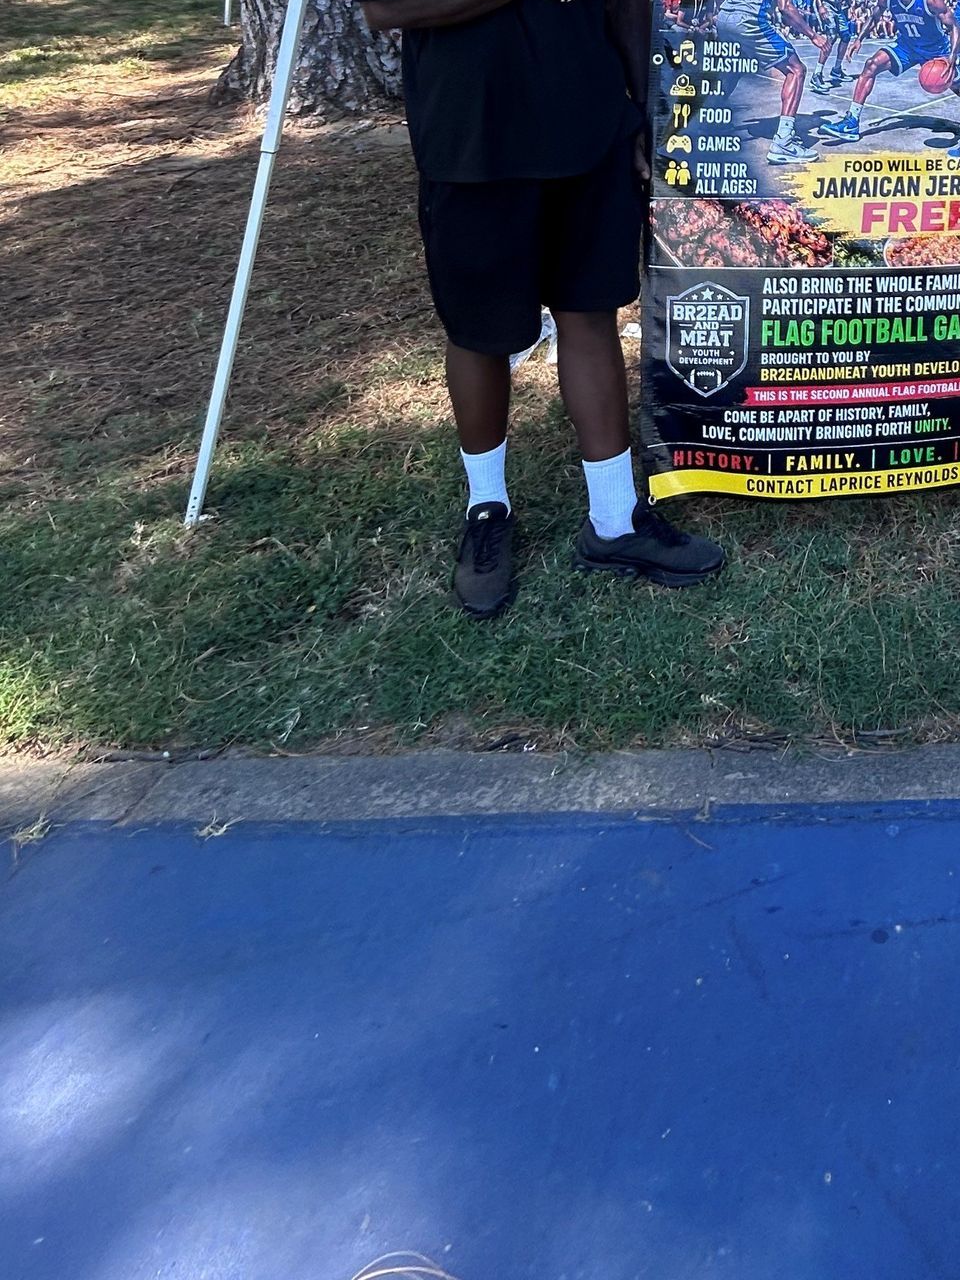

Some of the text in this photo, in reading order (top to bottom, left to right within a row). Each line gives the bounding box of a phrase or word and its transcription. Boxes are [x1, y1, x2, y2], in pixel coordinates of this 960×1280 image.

[904, 23, 921, 38] 11
[703, 40, 741, 57] MUSIC
[702, 57, 758, 73] BLASTING
[701, 80, 725, 95] D.J.
[699, 109, 731, 124] FOOD
[697, 137, 741, 152] GAMES
[696, 163, 748, 178] FUN FOR
[844, 160, 883, 173] FOOD
[888, 160, 921, 172] WILL
[925, 159, 943, 171] BE
[695, 179, 757, 194] ALL AGES!
[812, 176, 920, 199] JAMAICAN
[762, 278, 798, 294] ALSO
[801, 277, 843, 294] BRING
[846, 277, 872, 293] THE
[875, 276, 923, 293] WHOLE
[672, 304, 743, 321] BR2EAD
[762, 298, 852, 315] PARTICIPATE
[856, 298, 871, 314] IN
[874, 297, 902, 314] THE
[694, 321, 719, 330] AND
[761, 319, 815, 347] FLAG
[821, 314, 928, 346] FOOTBALL
[680, 331, 733, 347] MEAT
[678, 357, 734, 365] DEVELOPMENT
[692, 349, 720, 357] YOUTH
[761, 350, 871, 365] BROUGHT TO YOU BY
[760, 365, 867, 382] BR2EADANDMEAT
[870, 363, 911, 378] YOUTH
[754, 390, 776, 401] THIS
[778, 390, 788, 401] IS
[790, 389, 809, 400] THE
[810, 388, 850, 400] SECOND
[852, 387, 890, 399] ANNUAL
[892, 385, 915, 397] FLAG
[723, 403, 931, 424] COME BE APART OF HISTORY, FAMILY,
[702, 418, 951, 442] LOVE, COMMUNITY BRINGING FORTH UNITY.
[673, 450, 760, 471] HISTORY.
[785, 452, 861, 472] FAMILY.
[889, 446, 943, 465] LOVE.
[746, 478, 814, 495] CONTACT
[820, 474, 882, 493] LAPRICE
[887, 466, 959, 488] REYNOLDS
